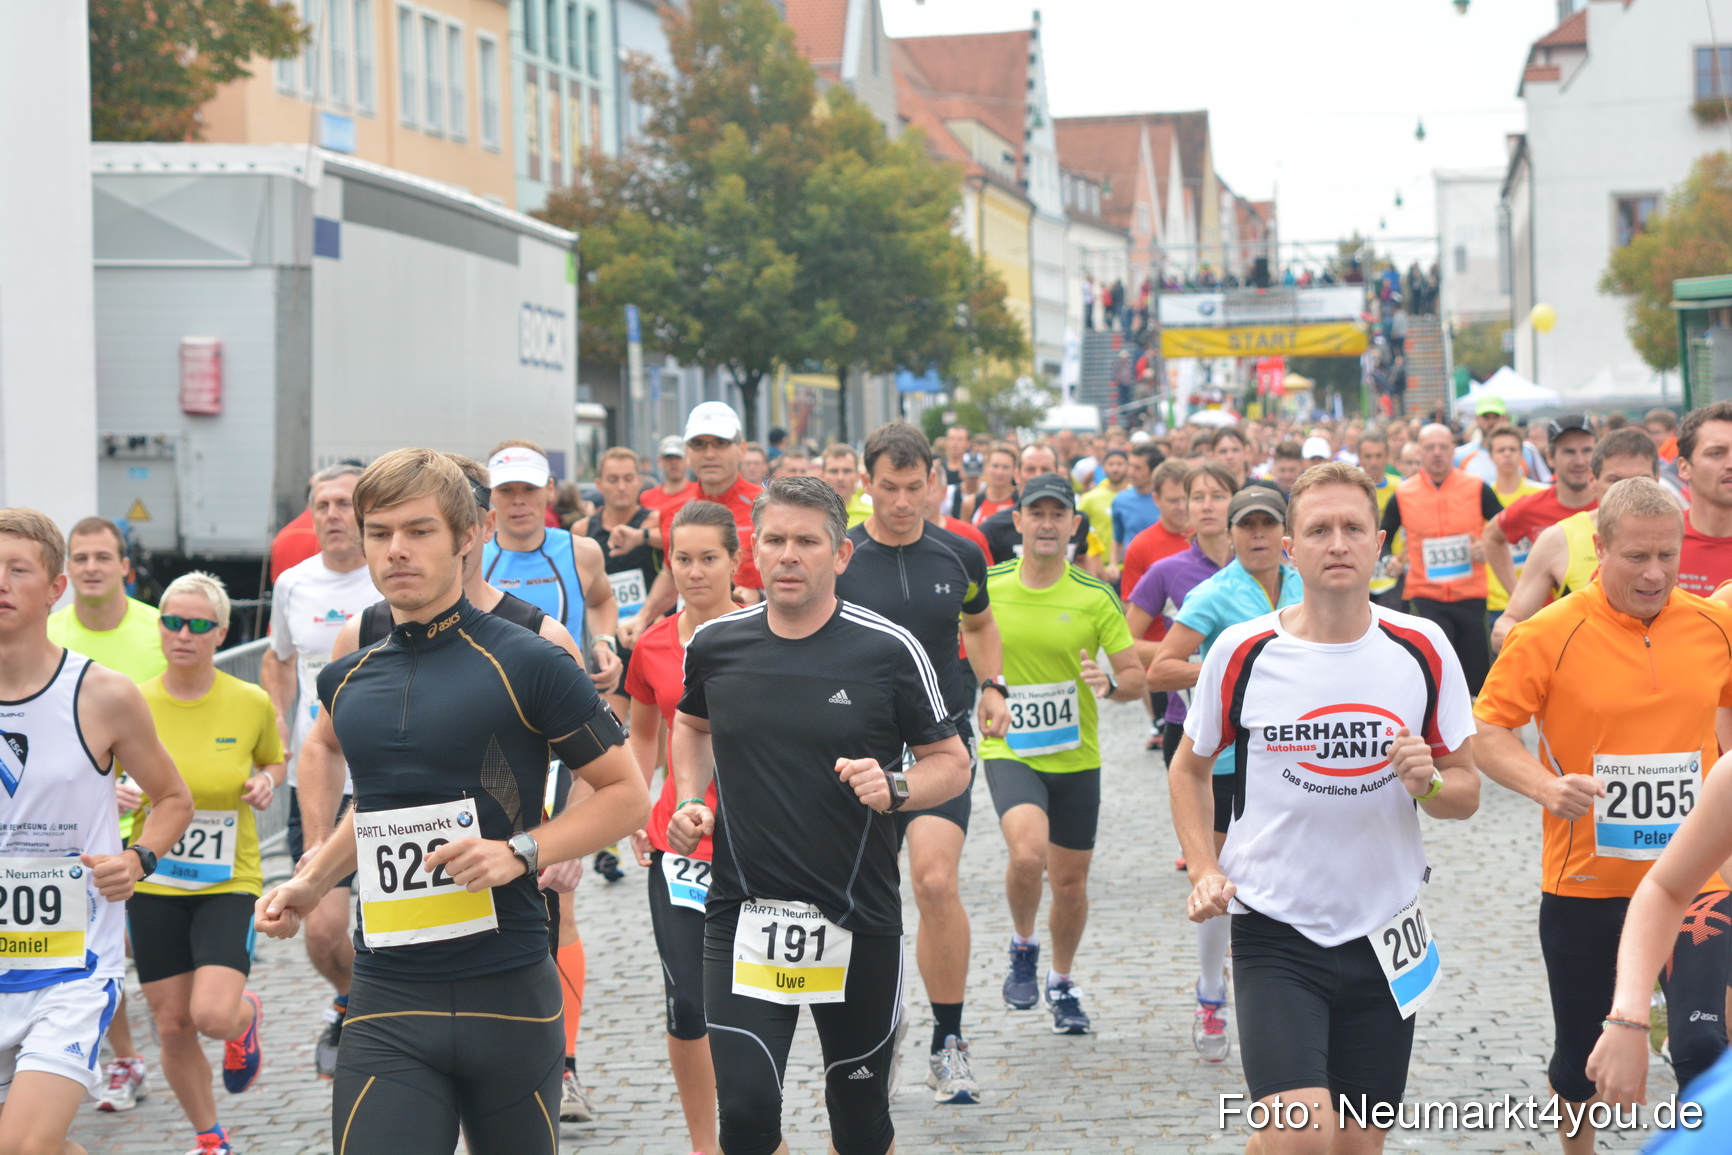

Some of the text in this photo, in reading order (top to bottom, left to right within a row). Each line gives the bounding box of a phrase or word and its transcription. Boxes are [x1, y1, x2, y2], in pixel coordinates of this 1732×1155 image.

[1228, 331, 1298, 351] START
[438, 611, 461, 632] asics
[828, 697, 852, 705] adidas
[1010, 698, 1073, 729] 3304
[1263, 721, 1395, 742] GERHART &
[7, 738, 24, 757] RSC
[1266, 743, 1317, 752] Autohaus
[1596, 763, 1688, 776] PARTL Neumarkt
[1282, 768, 1302, 786] Das
[1303, 781, 1358, 796] sportliche
[1606, 779, 1695, 819] 2055
[58, 823, 78, 831] RUHE
[357, 817, 452, 839] PARTL Neumarkt
[6, 869, 64, 879] Neumarkt
[169, 864, 199, 879] Jana
[376, 838, 456, 894] 622
[743, 903, 780, 916] PARTL
[0, 937, 48, 953] Daniel
[761, 921, 827, 963] 191
[776, 972, 806, 989] Uwe
[1700, 1012, 1719, 1022] asics
[848, 1072, 874, 1080] adidas
